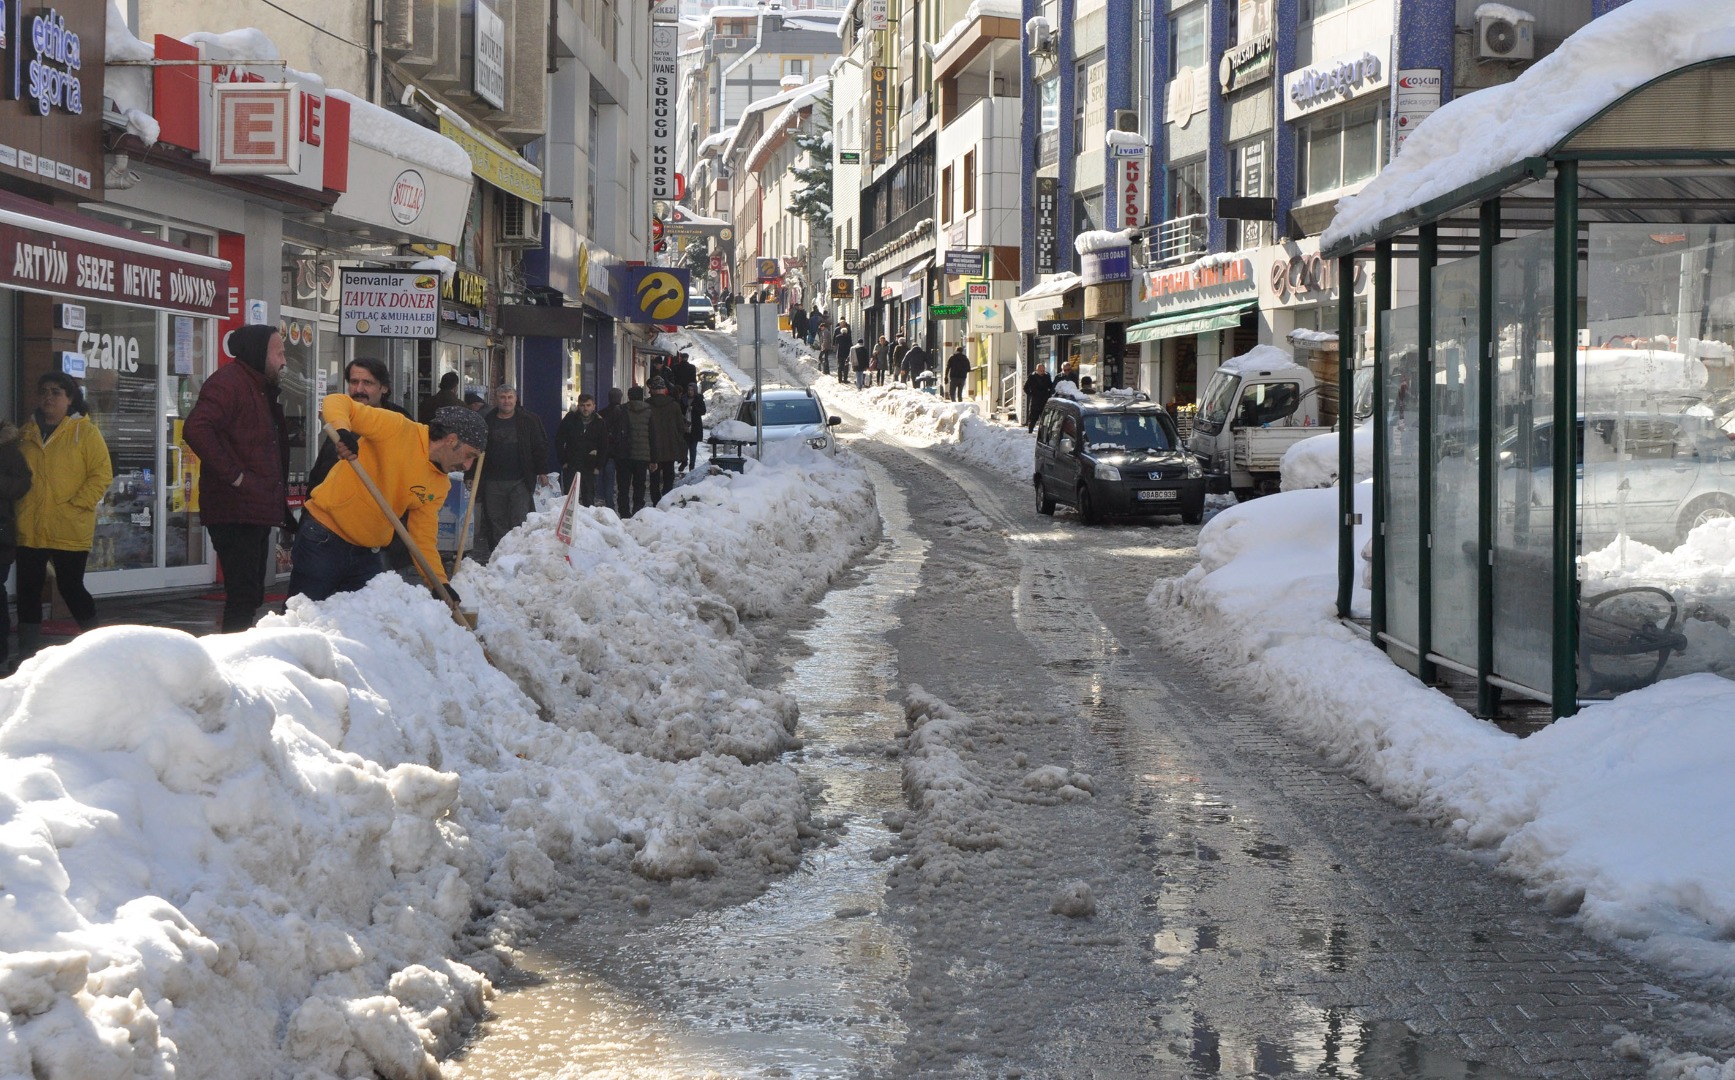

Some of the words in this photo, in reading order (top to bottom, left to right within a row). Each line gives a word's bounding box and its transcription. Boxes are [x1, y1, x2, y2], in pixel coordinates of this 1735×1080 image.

[32, 7, 81, 70] ethica
[29, 53, 83, 117] sigorta
[654, 77, 668, 138] SÜRÜCÜ
[233, 103, 276, 155] E
[1114, 145, 1144, 157] Livane
[653, 145, 667, 196] KURSU
[1125, 161, 1140, 227] KUAFÖR
[13, 241, 68, 285] ARTVİN
[76, 254, 115, 293] SEBZE
[123, 263, 161, 300] MEYVE
[170, 268, 216, 308] DÜNYASI
[345, 273, 405, 287] benvanlar
[970, 285, 987, 294] SPOR
[344, 290, 388, 307] TAVUK
[388, 289, 435, 309] DÖNER
[345, 311, 379, 322] SÜTLAÇ
[380, 324, 392, 334] Tel:
[394, 325, 409, 335] 212
[412, 326, 420, 335] 17
[423, 326, 434, 336] 00
[1052, 323, 1061, 331] 03
